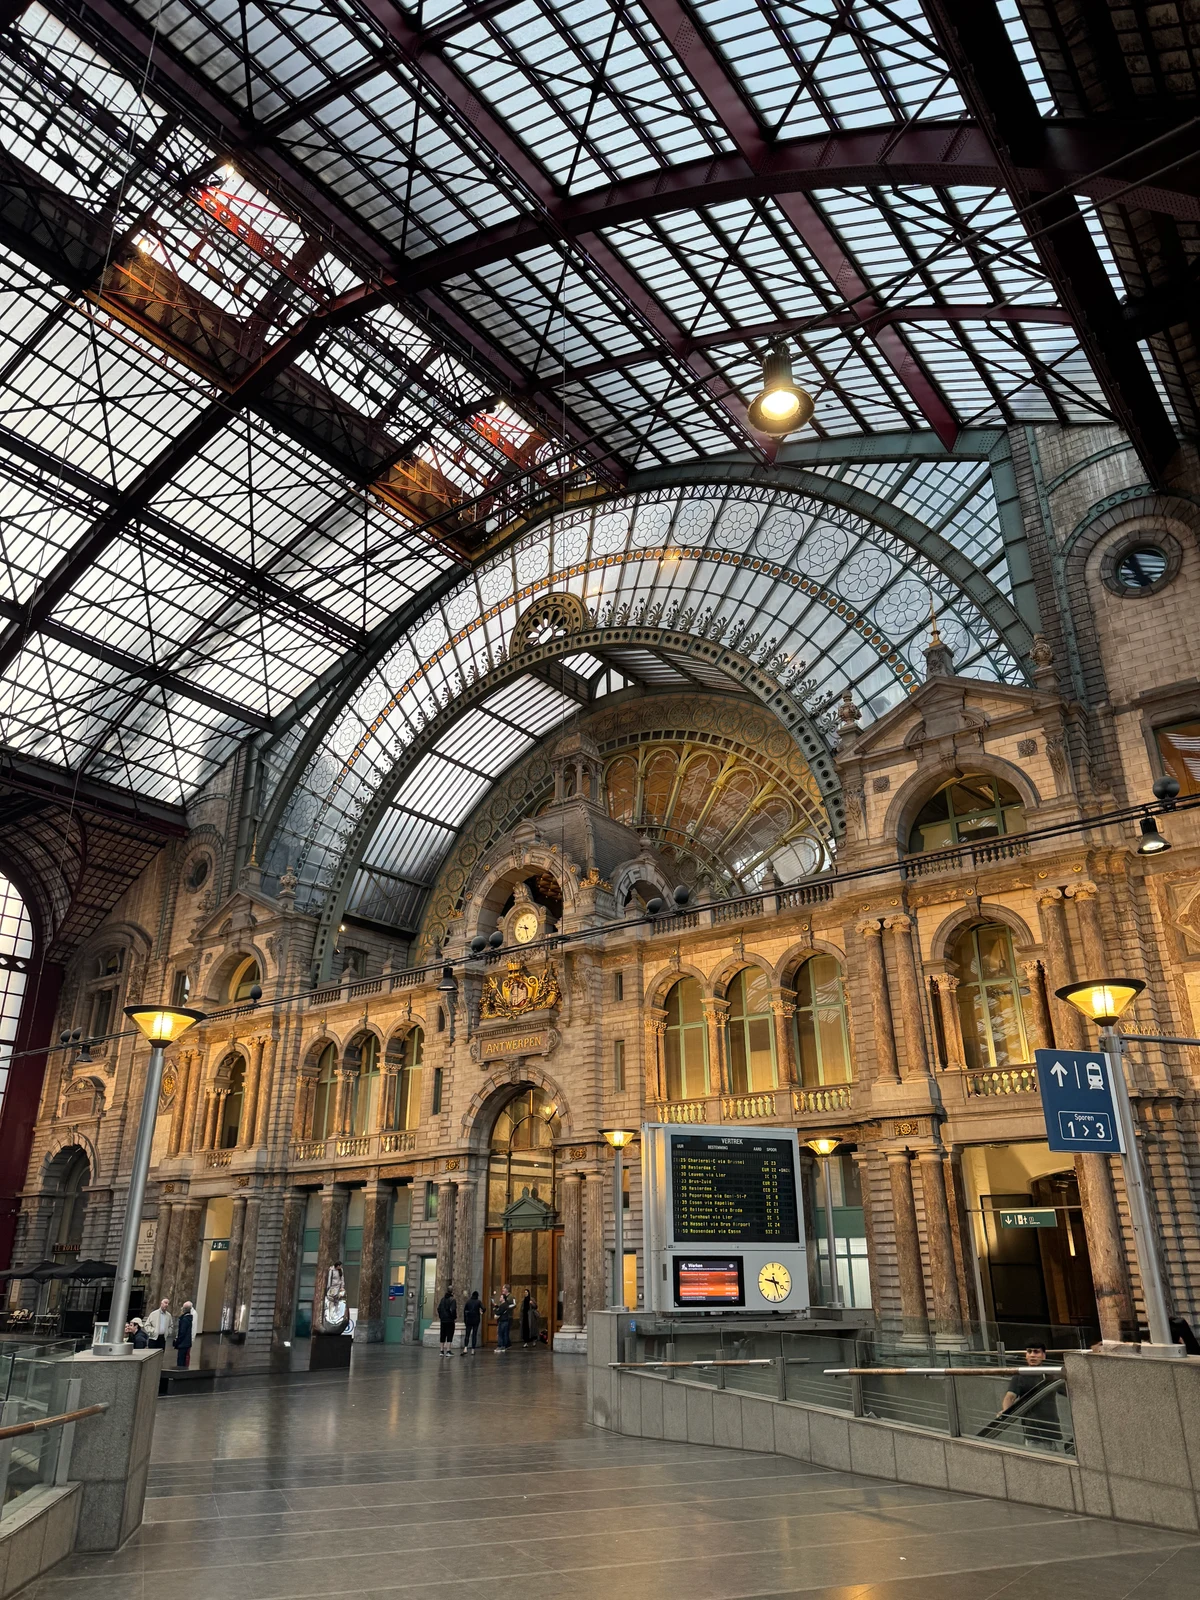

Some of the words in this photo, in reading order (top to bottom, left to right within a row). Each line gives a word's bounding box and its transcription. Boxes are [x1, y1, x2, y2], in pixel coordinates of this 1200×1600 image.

[486, 1036, 542, 1053] ANTWERPEN
[1074, 1114, 1095, 1122] Sporen
[1068, 1122, 1075, 1137] 1
[1096, 1122, 1105, 1138] 3
